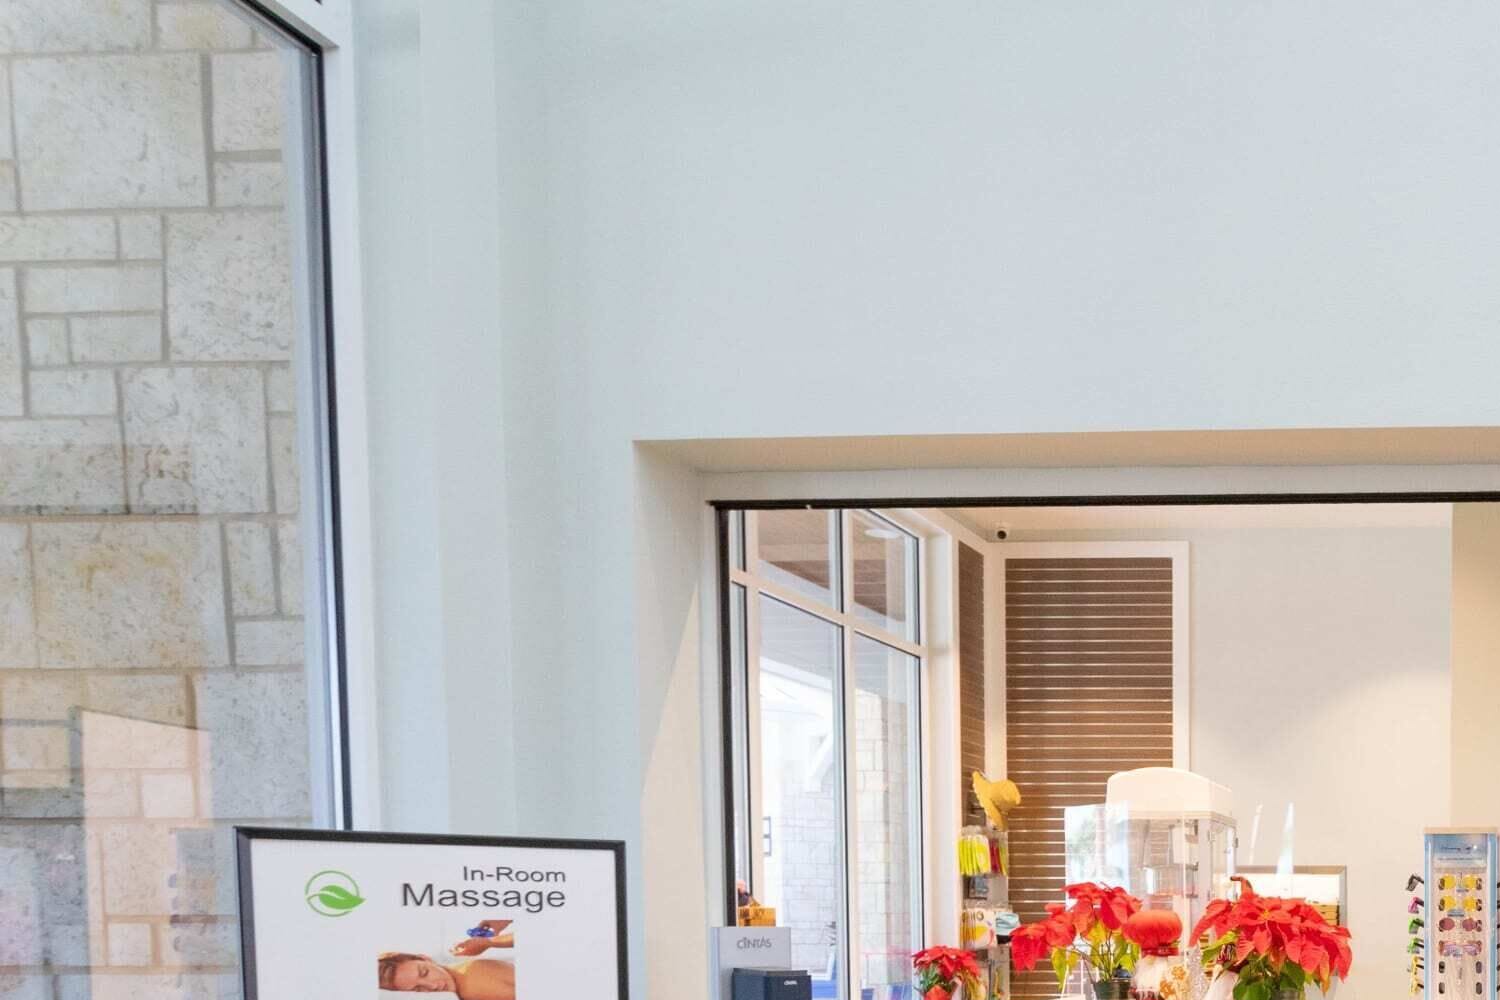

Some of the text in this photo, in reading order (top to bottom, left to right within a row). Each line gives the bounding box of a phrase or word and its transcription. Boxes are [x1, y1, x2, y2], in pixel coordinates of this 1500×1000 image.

[463, 866, 566, 883] In-Room
[402, 883, 566, 913] Massage
[737, 937, 773, 949] CINTAS
